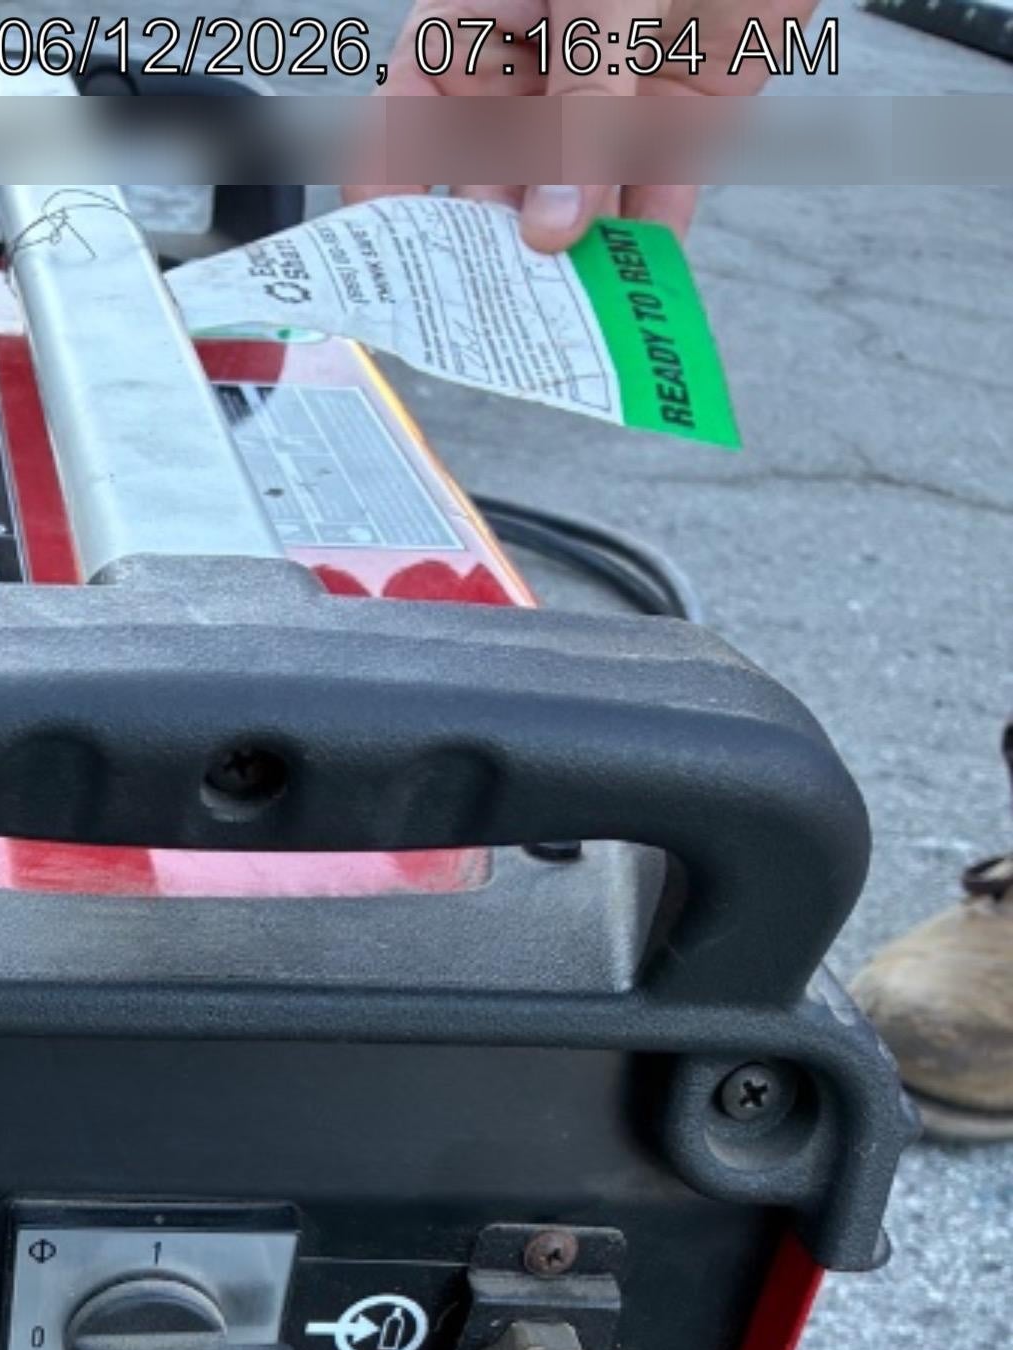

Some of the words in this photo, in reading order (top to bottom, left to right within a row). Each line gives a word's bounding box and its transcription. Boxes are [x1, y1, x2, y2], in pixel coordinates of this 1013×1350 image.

[599, 223, 654, 286] RENT
[628, 291, 667, 322] TO
[640, 327, 696, 429] READY
